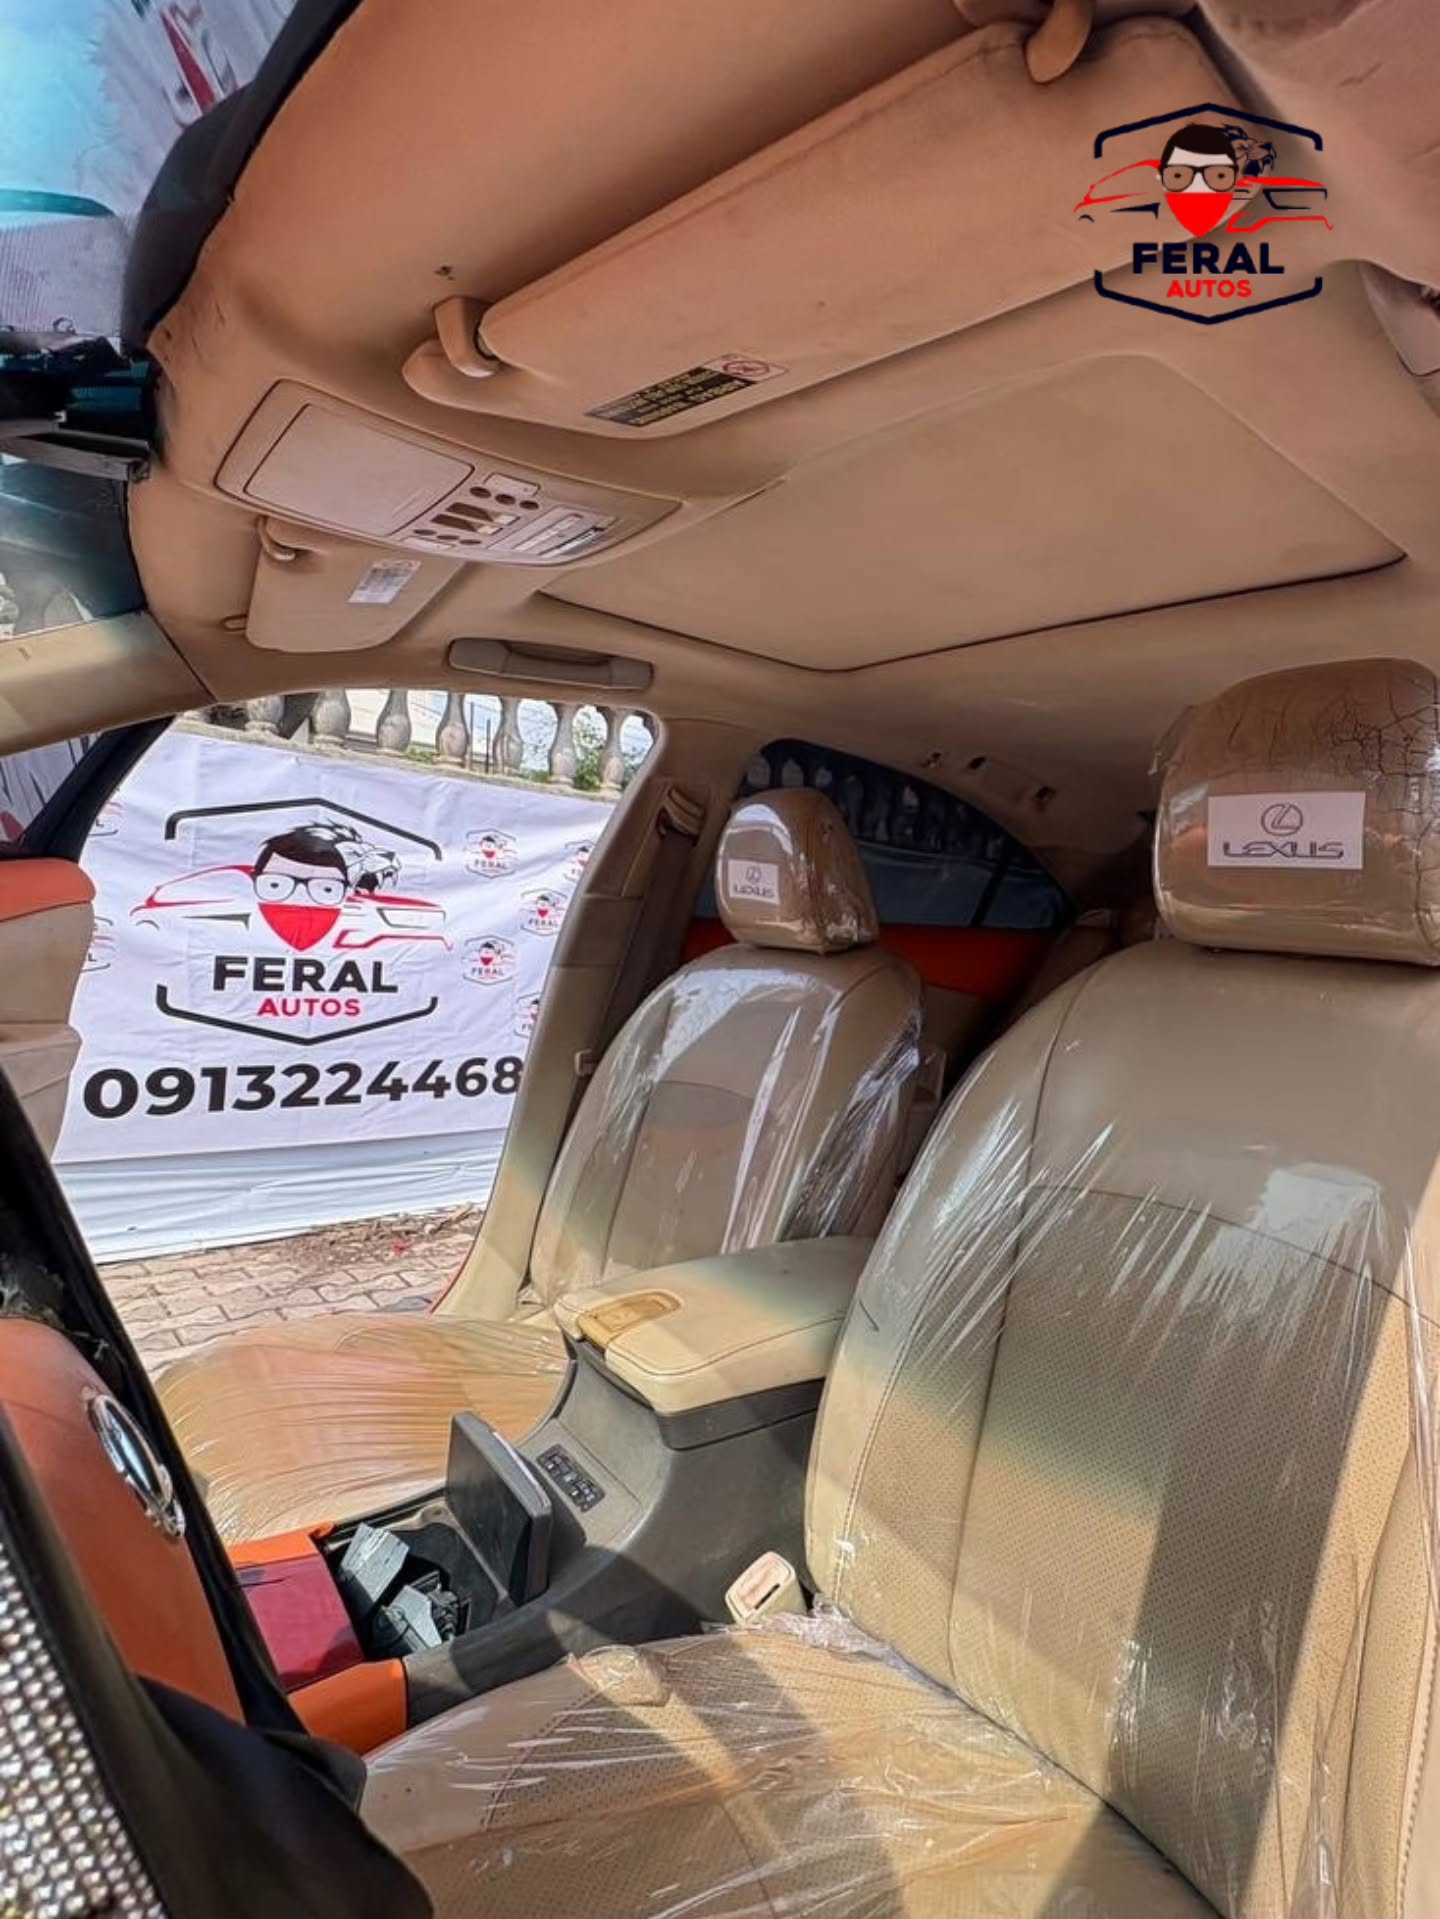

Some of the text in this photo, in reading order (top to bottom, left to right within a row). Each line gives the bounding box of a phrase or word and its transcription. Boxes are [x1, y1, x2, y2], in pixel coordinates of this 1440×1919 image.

[1223, 840, 1344, 859] LEXUS
[213, 955, 399, 993] FERAL
[256, 998, 361, 1017] AUTOS
[83, 1056, 523, 1119] 0913224468
